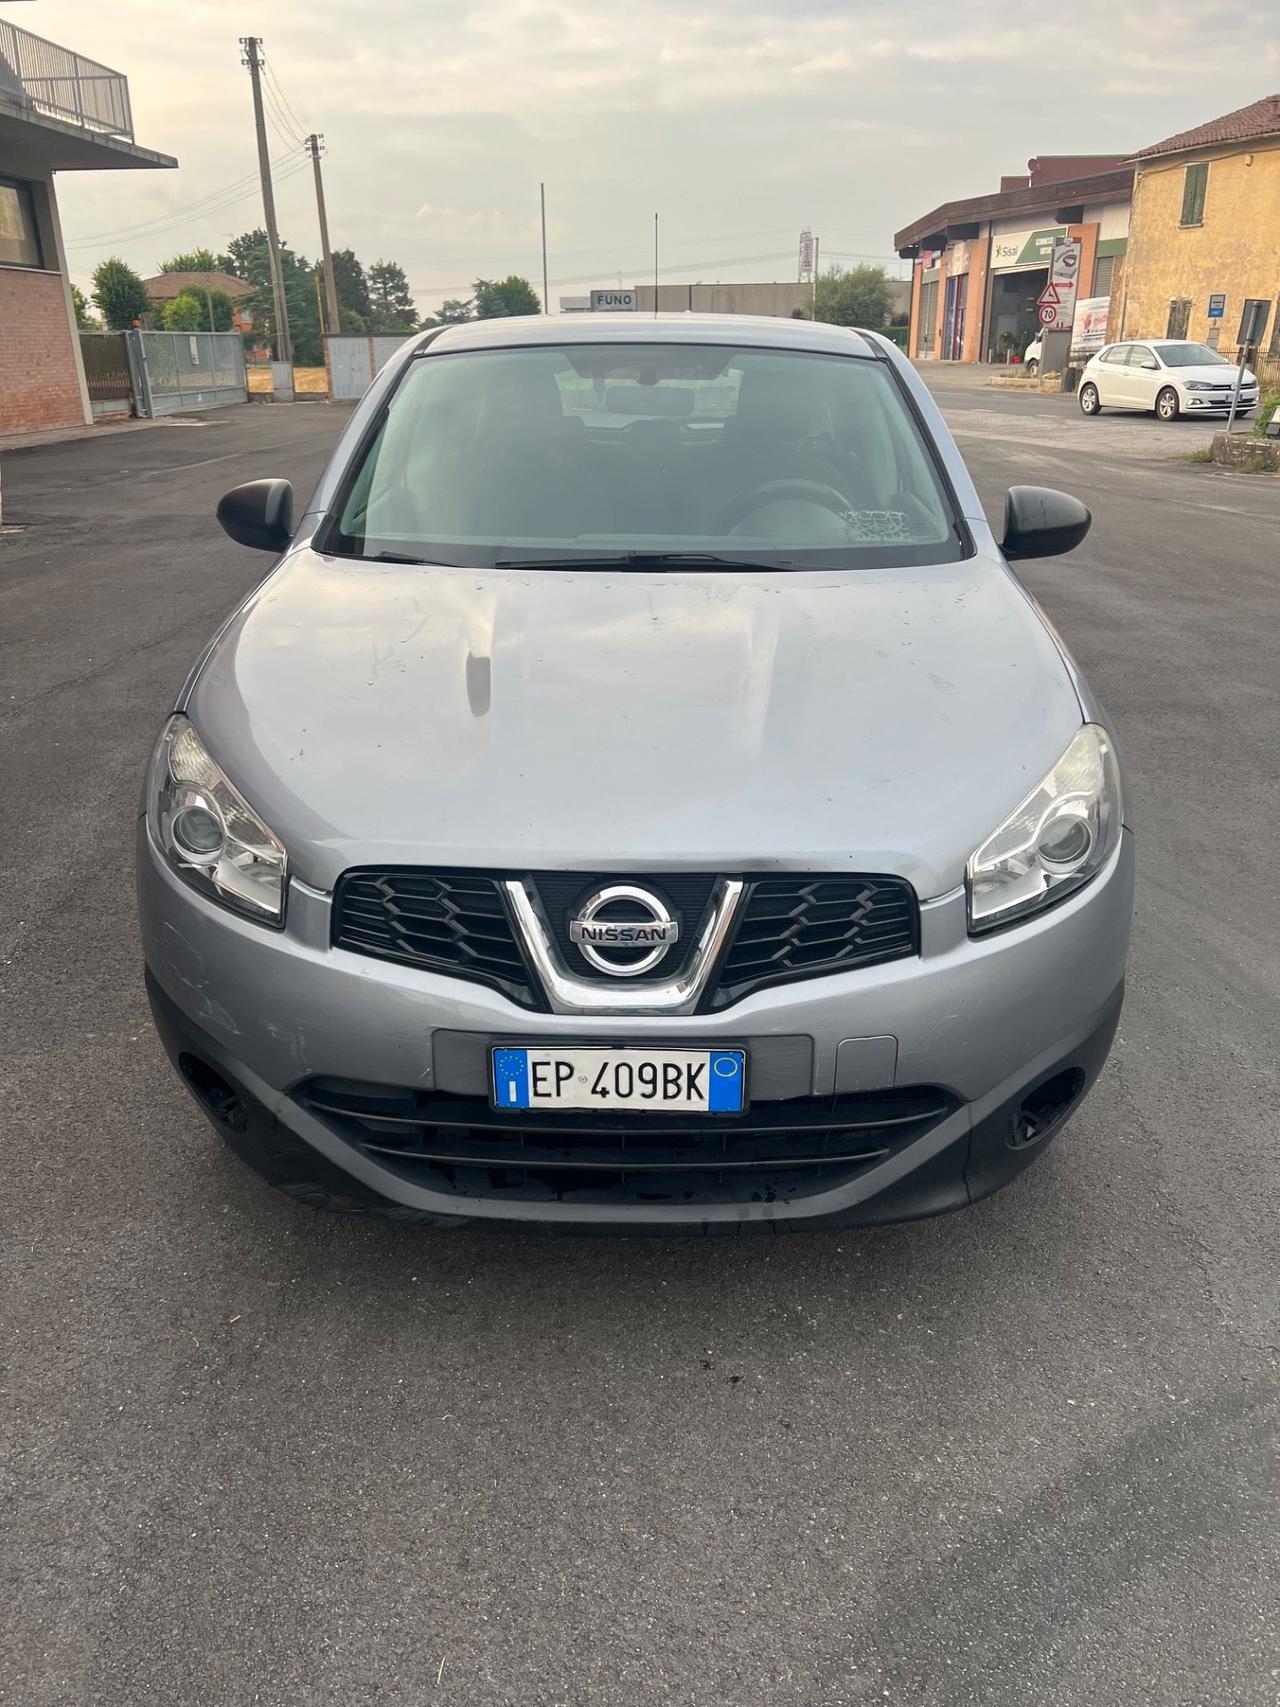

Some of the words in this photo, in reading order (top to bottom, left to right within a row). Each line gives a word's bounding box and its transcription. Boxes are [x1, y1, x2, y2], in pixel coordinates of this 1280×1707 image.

[597, 295, 632, 305] FUNO
[1044, 310, 1053, 319] 70
[581, 927, 666, 941] NISSAN
[531, 1061, 575, 1098] EP
[591, 1061, 706, 1101] 409BK
